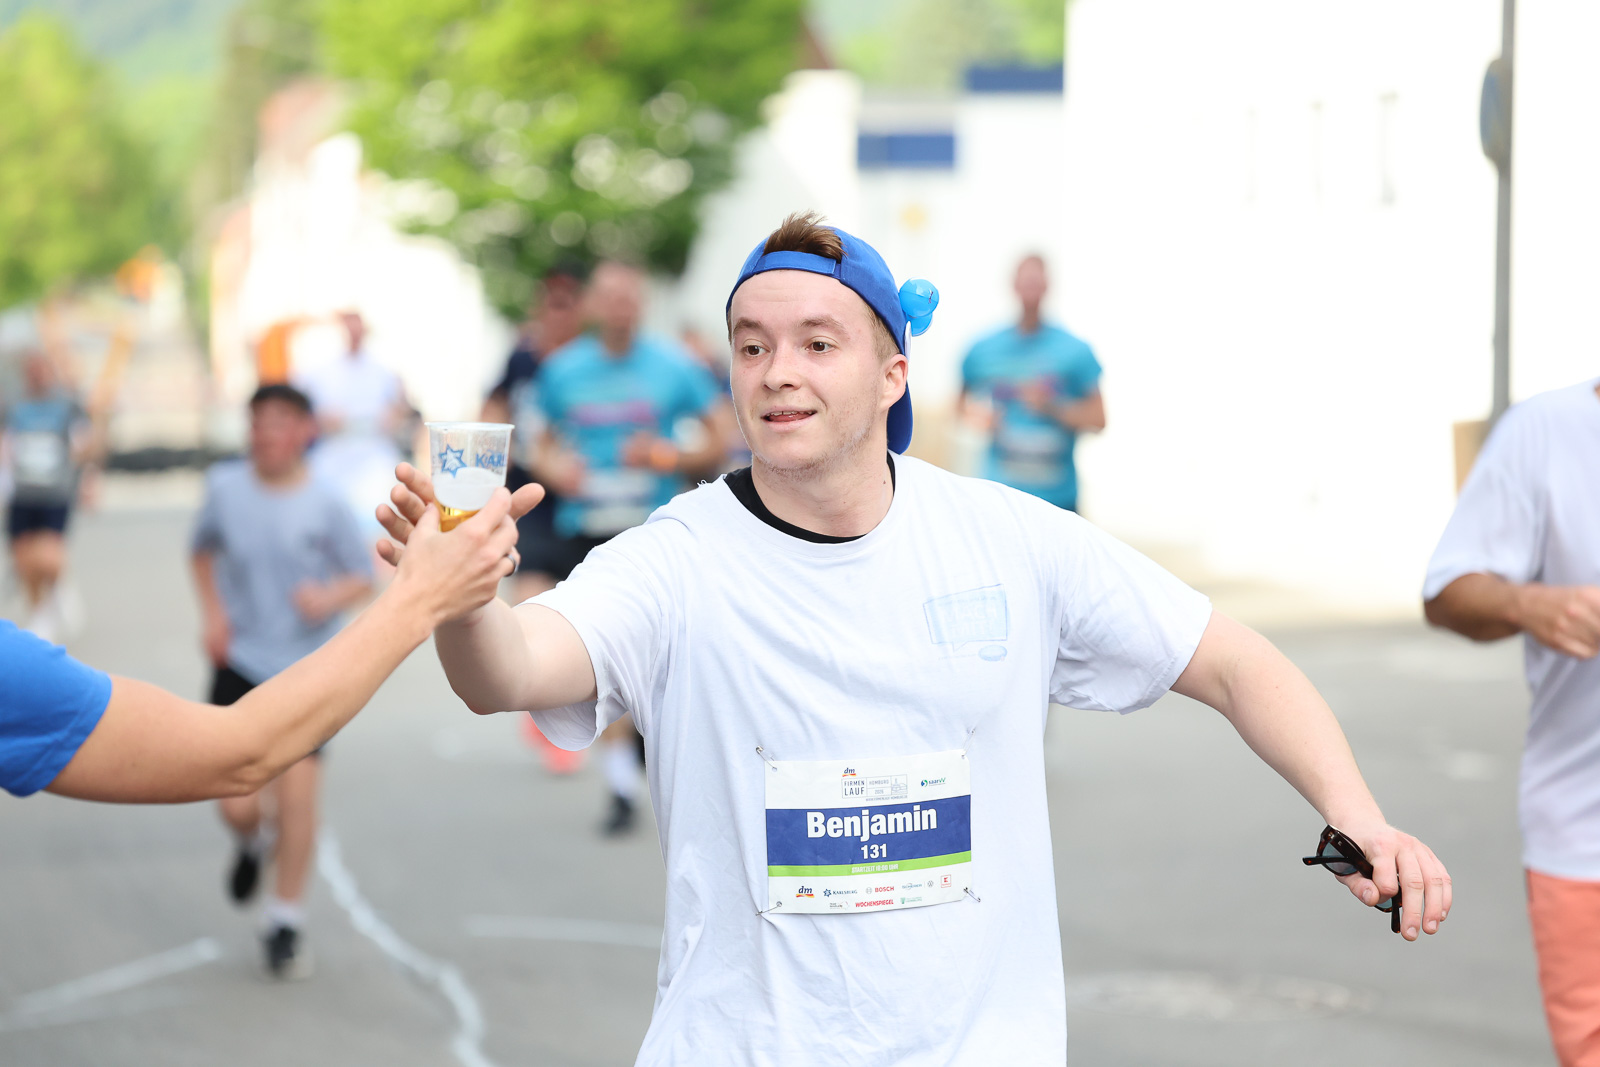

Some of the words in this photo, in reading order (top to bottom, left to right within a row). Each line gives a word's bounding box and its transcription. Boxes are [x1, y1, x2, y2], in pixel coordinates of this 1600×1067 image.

[844, 787, 865, 796] LAUF
[806, 805, 938, 842] Benjamin
[860, 843, 887, 860] 131
[851, 865, 875, 874] STARTZEIT
[798, 885, 813, 894] dm
[855, 899, 894, 908] WOCHENSPIEGEL
